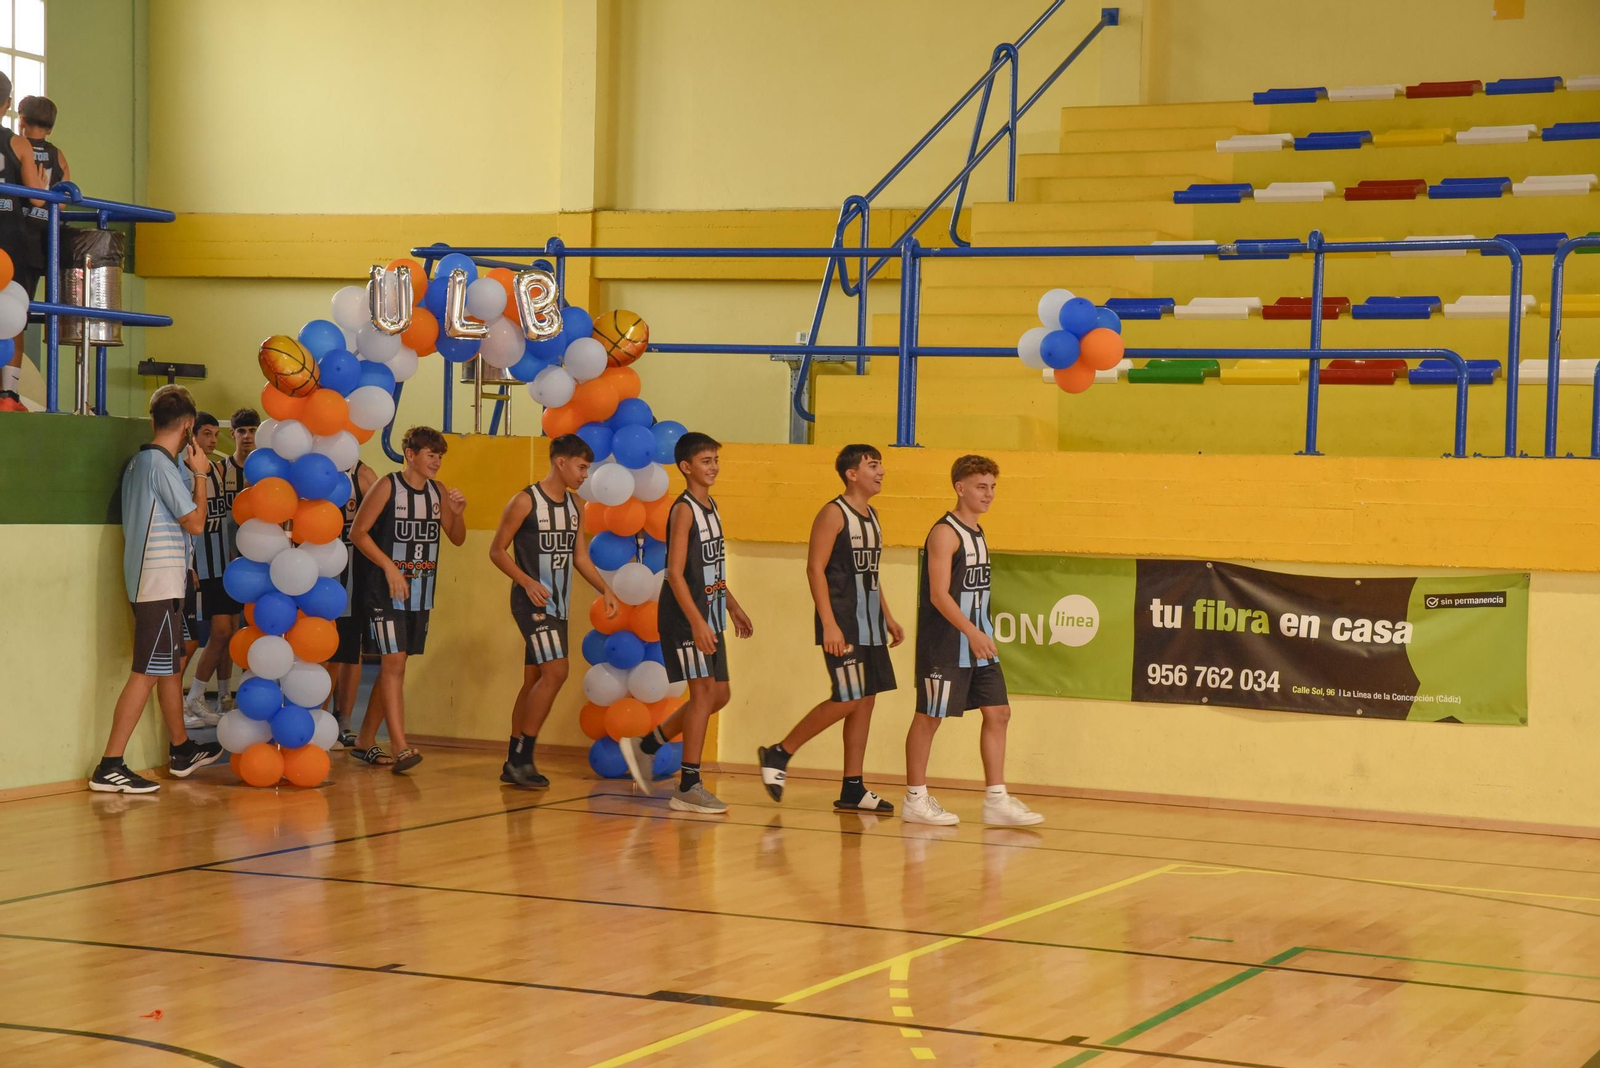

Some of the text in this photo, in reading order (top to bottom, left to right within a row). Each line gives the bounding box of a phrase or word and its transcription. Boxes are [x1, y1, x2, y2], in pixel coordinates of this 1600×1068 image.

[369, 264, 564, 342] ULB
[207, 498, 226, 518] LB
[207, 518, 221, 533] 77
[394, 520, 440, 542] ULB
[414, 543, 424, 560] 8
[552, 553, 569, 570] 27
[1440, 595, 1504, 606] sin permanencia
[1055, 611, 1094, 628] linea
[1150, 598, 1413, 644] tu fibra en casa
[1147, 663, 1281, 693] 956 762 034
[1292, 685, 1310, 695] Calle
[1311, 687, 1325, 697] Sol,
[1326, 688, 1336, 696] 96
[1342, 689, 1352, 698] La
[1373, 691, 1382, 700] de
[1383, 692, 1391, 701] la
[1392, 693, 1434, 703] Concepción
[1436, 694, 1462, 705] (Cádiz)
